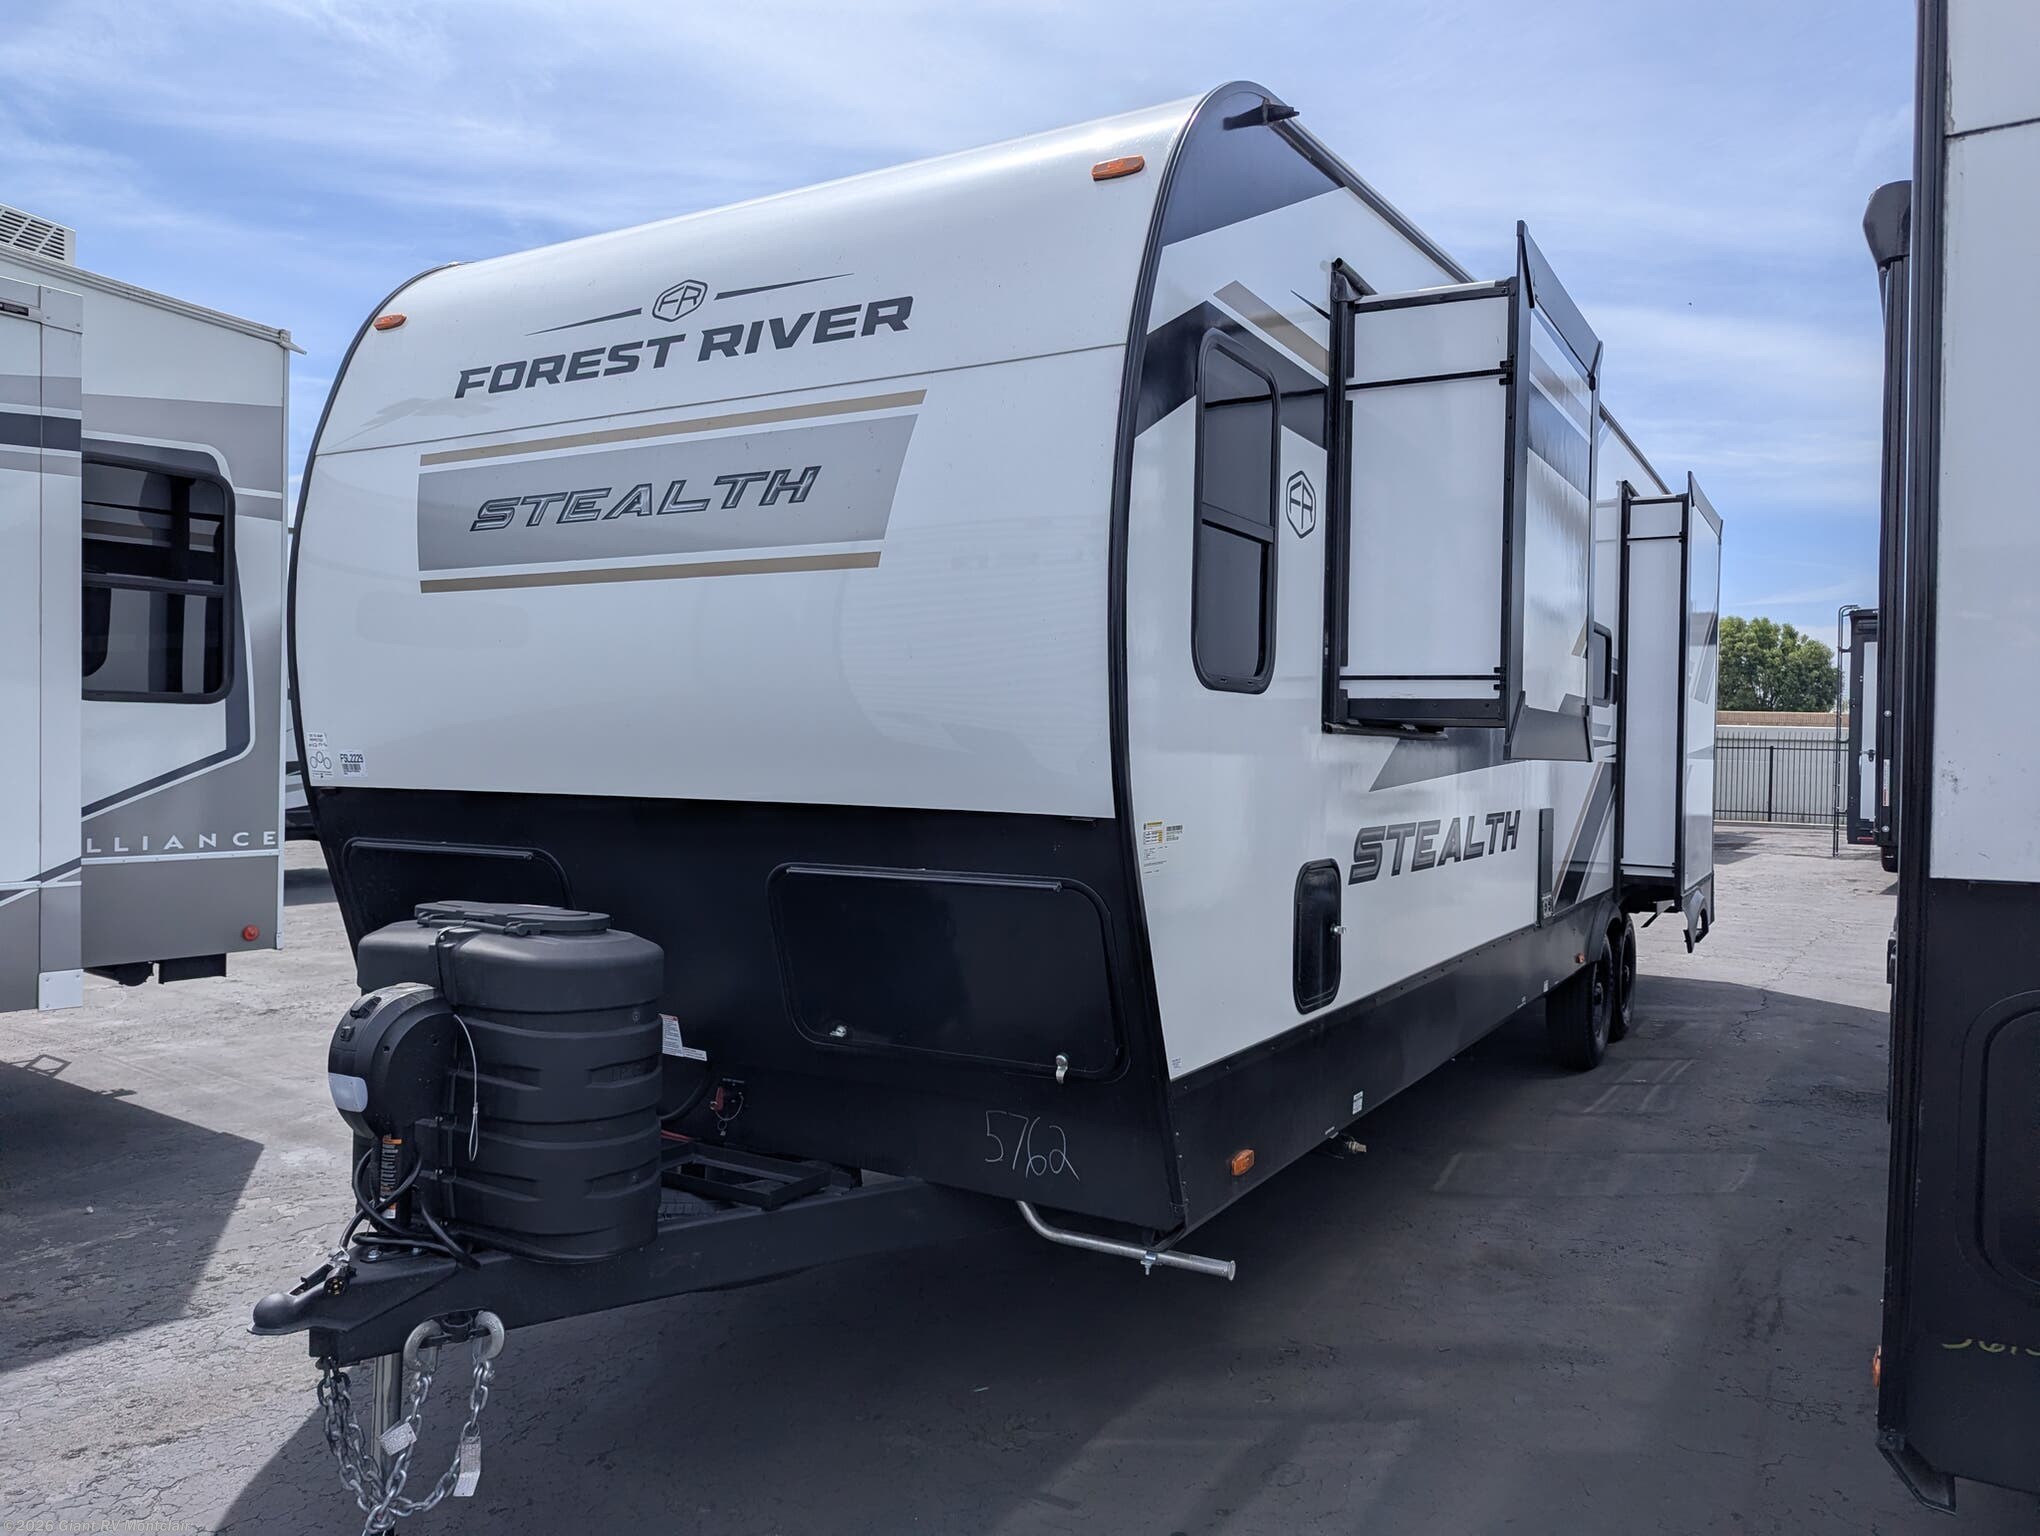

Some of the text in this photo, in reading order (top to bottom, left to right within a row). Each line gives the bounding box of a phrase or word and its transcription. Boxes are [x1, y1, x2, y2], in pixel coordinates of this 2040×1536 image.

[454, 295, 914, 399] FOREST RIVER
[469, 465, 822, 532] STEALTH
[86, 831, 277, 853] LLIANCE
[1347, 809, 1521, 886] STEALTH
[984, 1110, 1081, 1181] 5762
